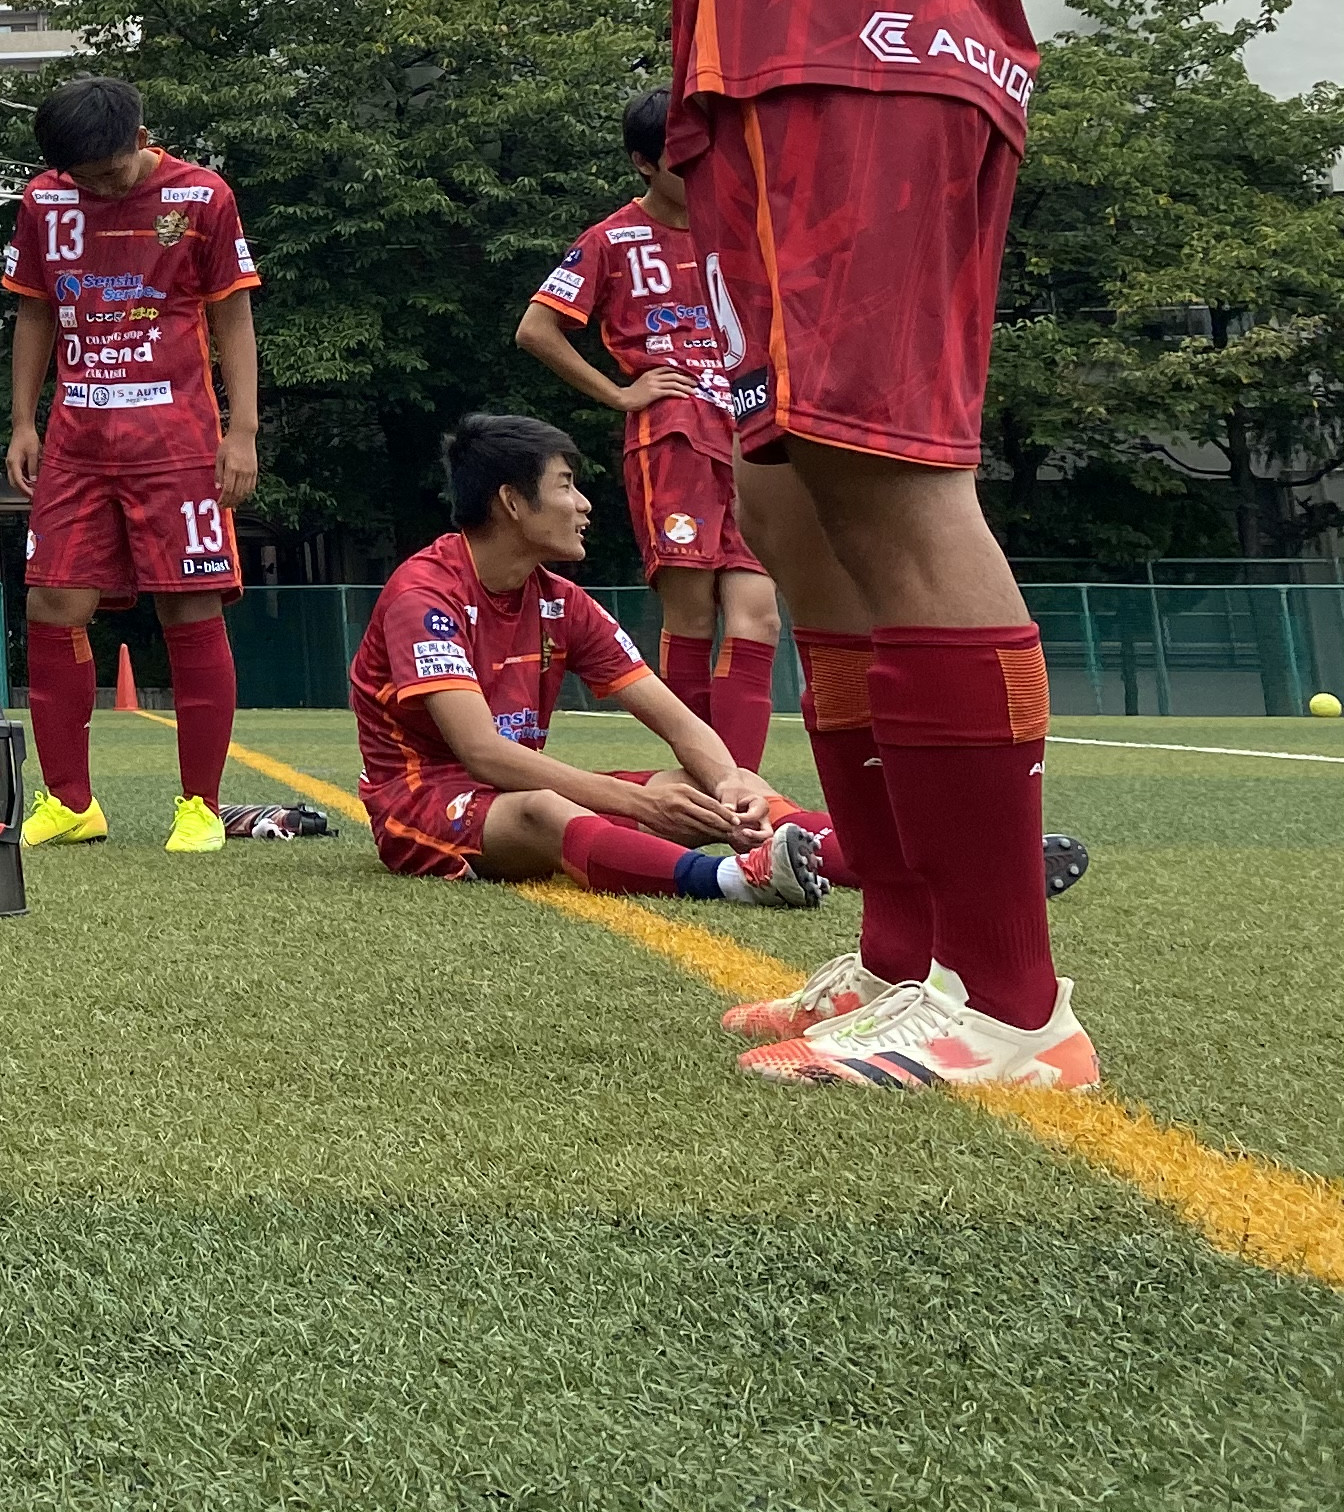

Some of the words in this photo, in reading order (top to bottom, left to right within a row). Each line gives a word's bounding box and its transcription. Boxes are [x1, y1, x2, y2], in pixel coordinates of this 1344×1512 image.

[45, 209, 86, 262] 13
[627, 243, 673, 299] 15
[136, 386, 168, 397] AUTO
[180, 498, 223, 555] 13
